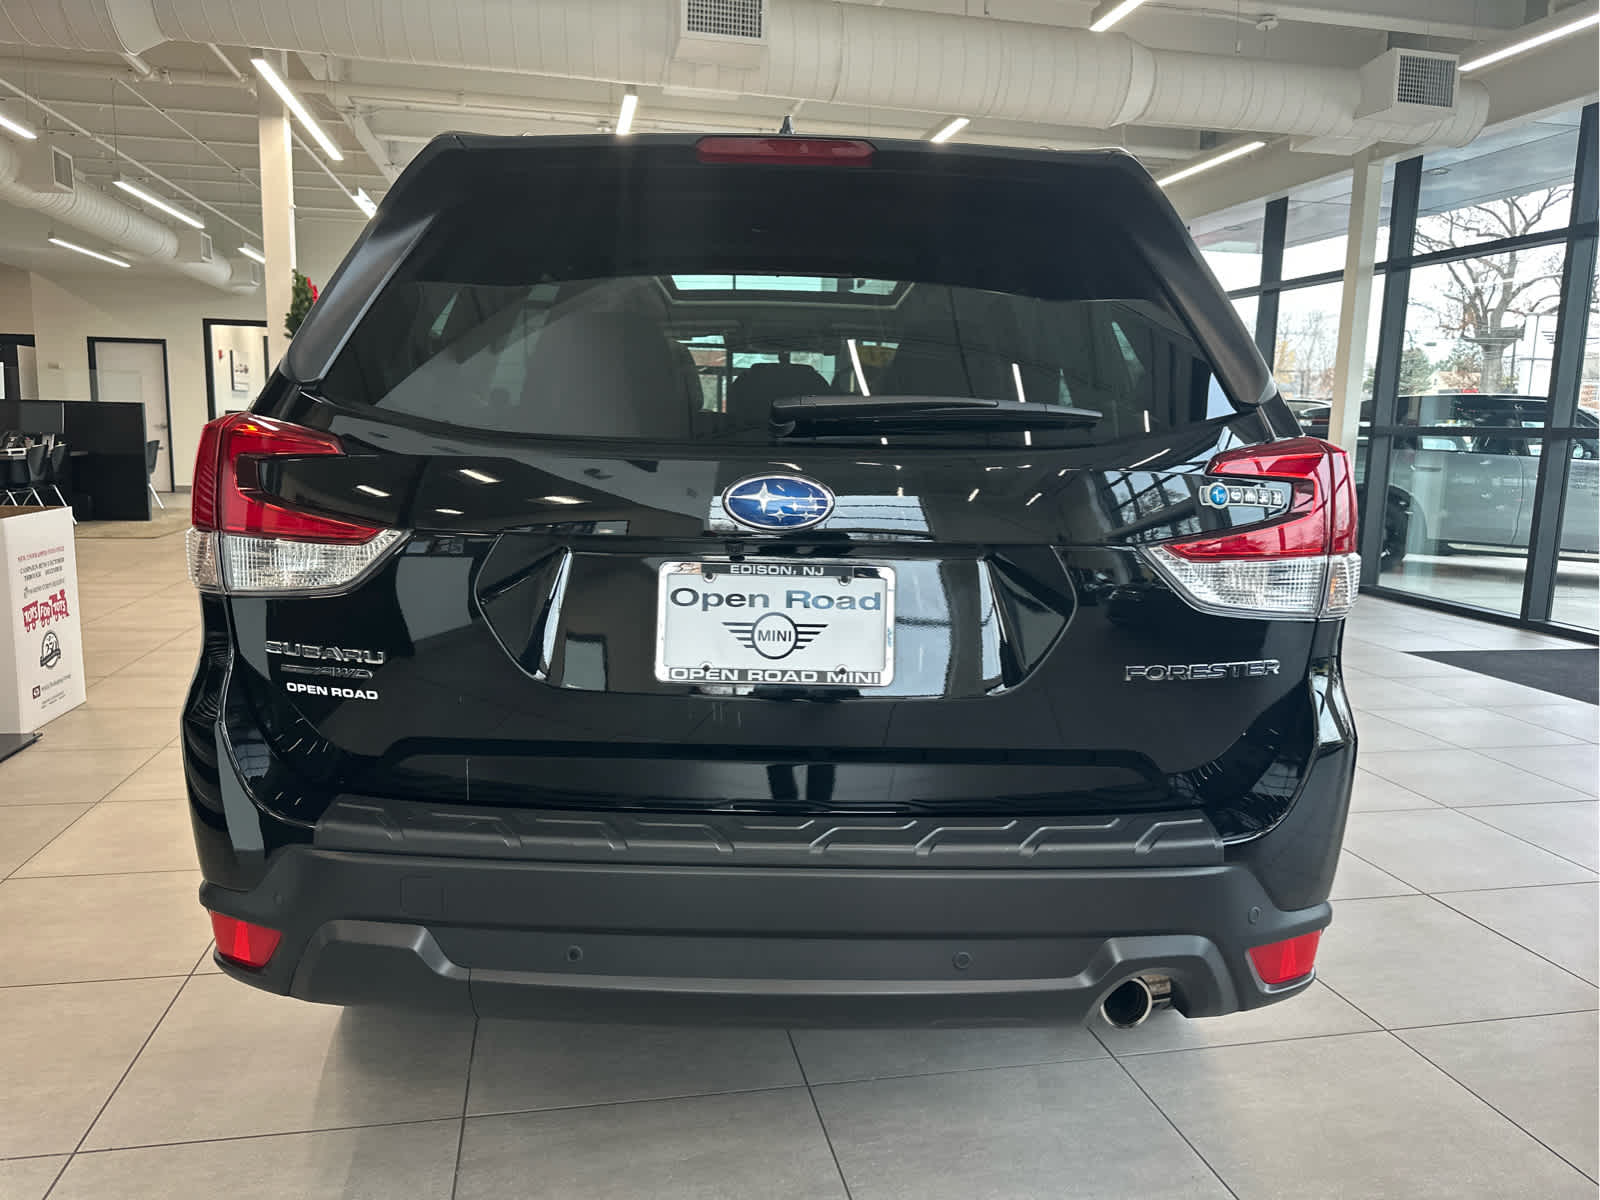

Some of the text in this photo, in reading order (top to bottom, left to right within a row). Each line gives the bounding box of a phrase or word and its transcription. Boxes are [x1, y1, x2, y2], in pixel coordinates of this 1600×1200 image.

[730, 564, 825, 576] EDISON, NJ
[670, 587, 881, 611] Open Road
[757, 629, 792, 642] MINI
[265, 640, 384, 664] SUBARU
[670, 668, 880, 684] OPEN ROAD MINI
[1125, 659, 1280, 681] FORESTER
[286, 682, 379, 700] OPEN ROAD
